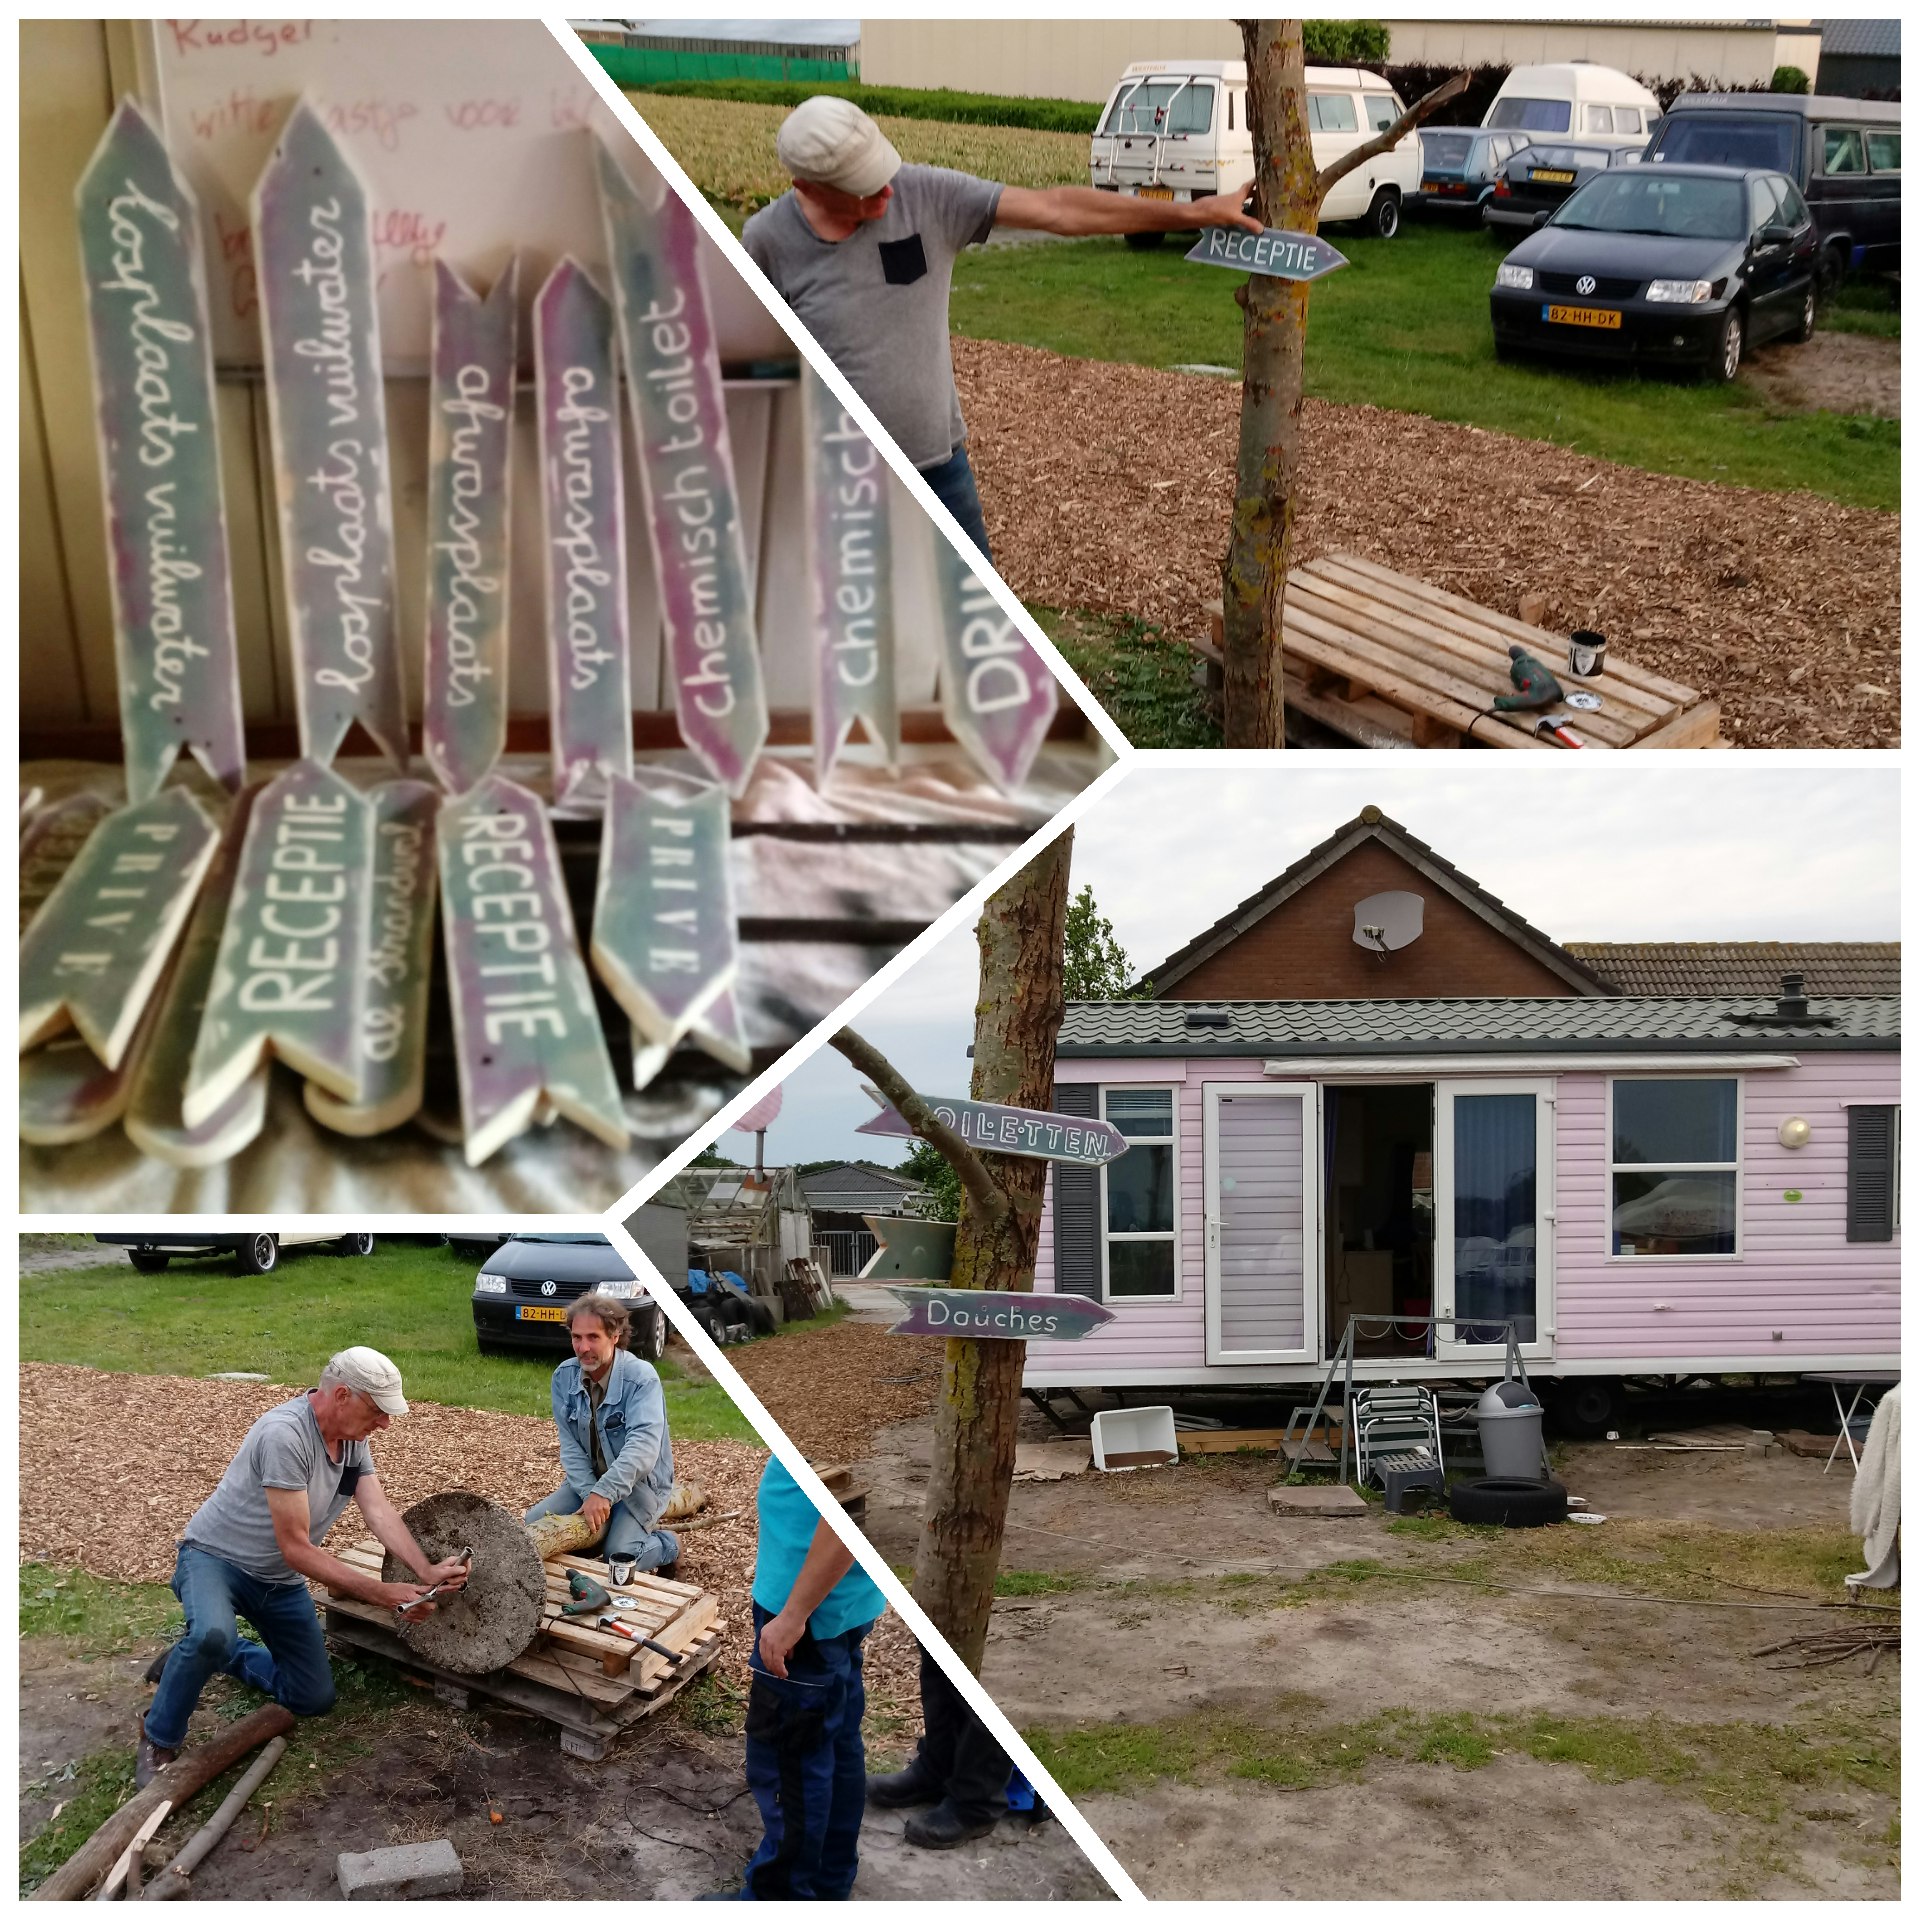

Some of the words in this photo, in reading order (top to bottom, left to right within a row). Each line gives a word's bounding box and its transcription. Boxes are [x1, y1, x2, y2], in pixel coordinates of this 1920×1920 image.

[100, 177, 198, 467] losplaats
[290, 197, 359, 426] vuilwater
[1209, 227, 1318, 271] RECEPTIE
[639, 286, 706, 455] toilet
[144, 482, 210, 711] vuilwater
[306, 439, 383, 695] losplaats
[434, 364, 505, 707] afwasplaats
[554, 366, 616, 691] afwasplaats
[238, 793, 348, 1013] RECEPTIE
[458, 812, 568, 1045] RECEPTIE
[648, 817, 700, 974] PRIVE
[927, 1299, 1059, 1332] Douches
